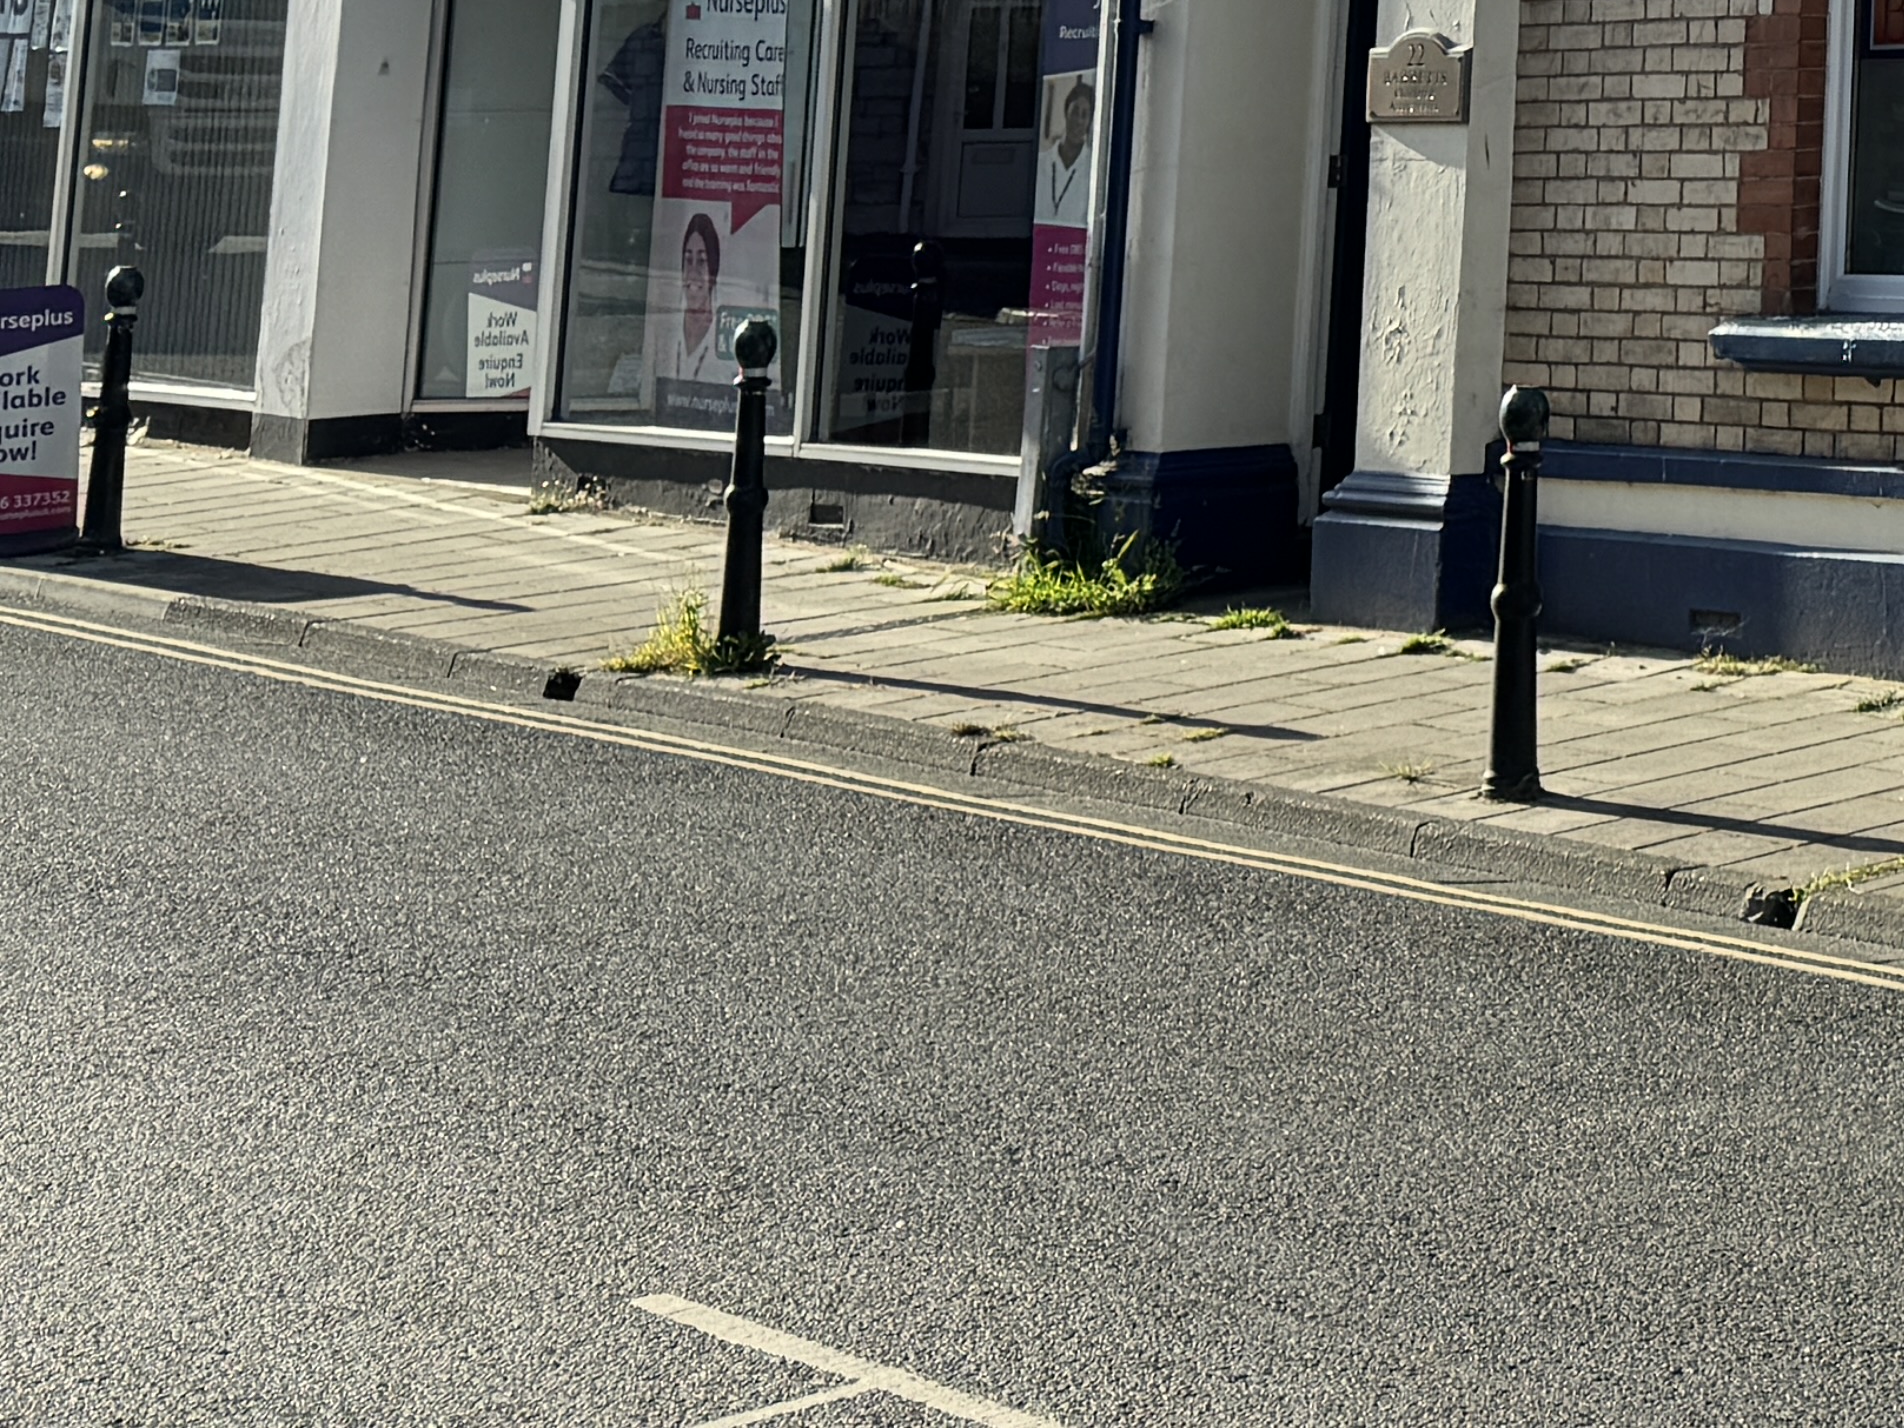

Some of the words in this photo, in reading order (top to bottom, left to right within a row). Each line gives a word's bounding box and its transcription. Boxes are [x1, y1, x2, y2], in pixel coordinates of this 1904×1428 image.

[1059, 25, 1100, 40] Recruit
[686, 37, 750, 67] Recruiting
[755, 39, 784, 63] Care
[1407, 43, 1425, 67] 22
[683, 70, 696, 93] &
[697, 71, 747, 101] Nursing
[0, 309, 73, 332] rseplus
[0, 365, 40, 387] ork
[0, 386, 67, 411] lable
[0, 440, 37, 464] ow!
[0, 494, 9, 510] 6
[13, 490, 71, 510] 337352
